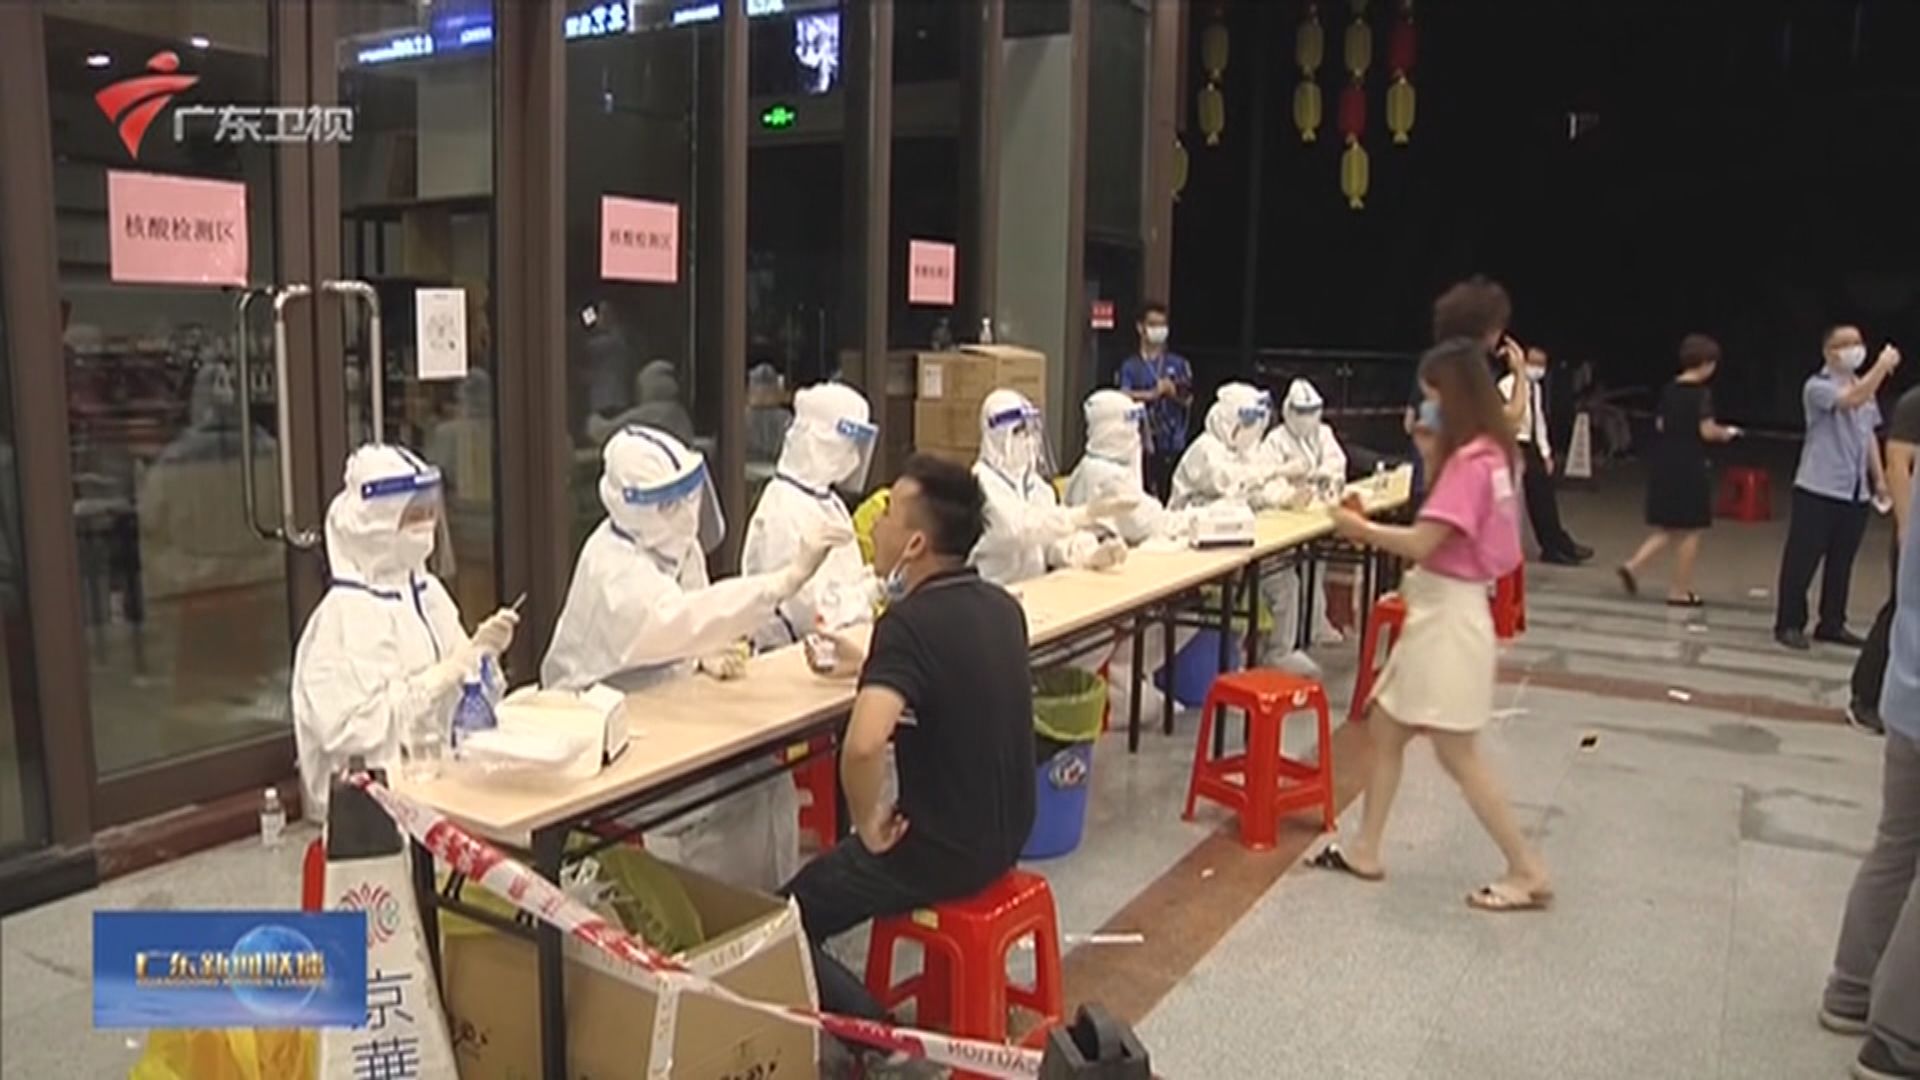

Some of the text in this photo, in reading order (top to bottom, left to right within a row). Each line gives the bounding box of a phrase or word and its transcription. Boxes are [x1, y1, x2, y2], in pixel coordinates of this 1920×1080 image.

[125, 213, 235, 242] 核酸检测区
